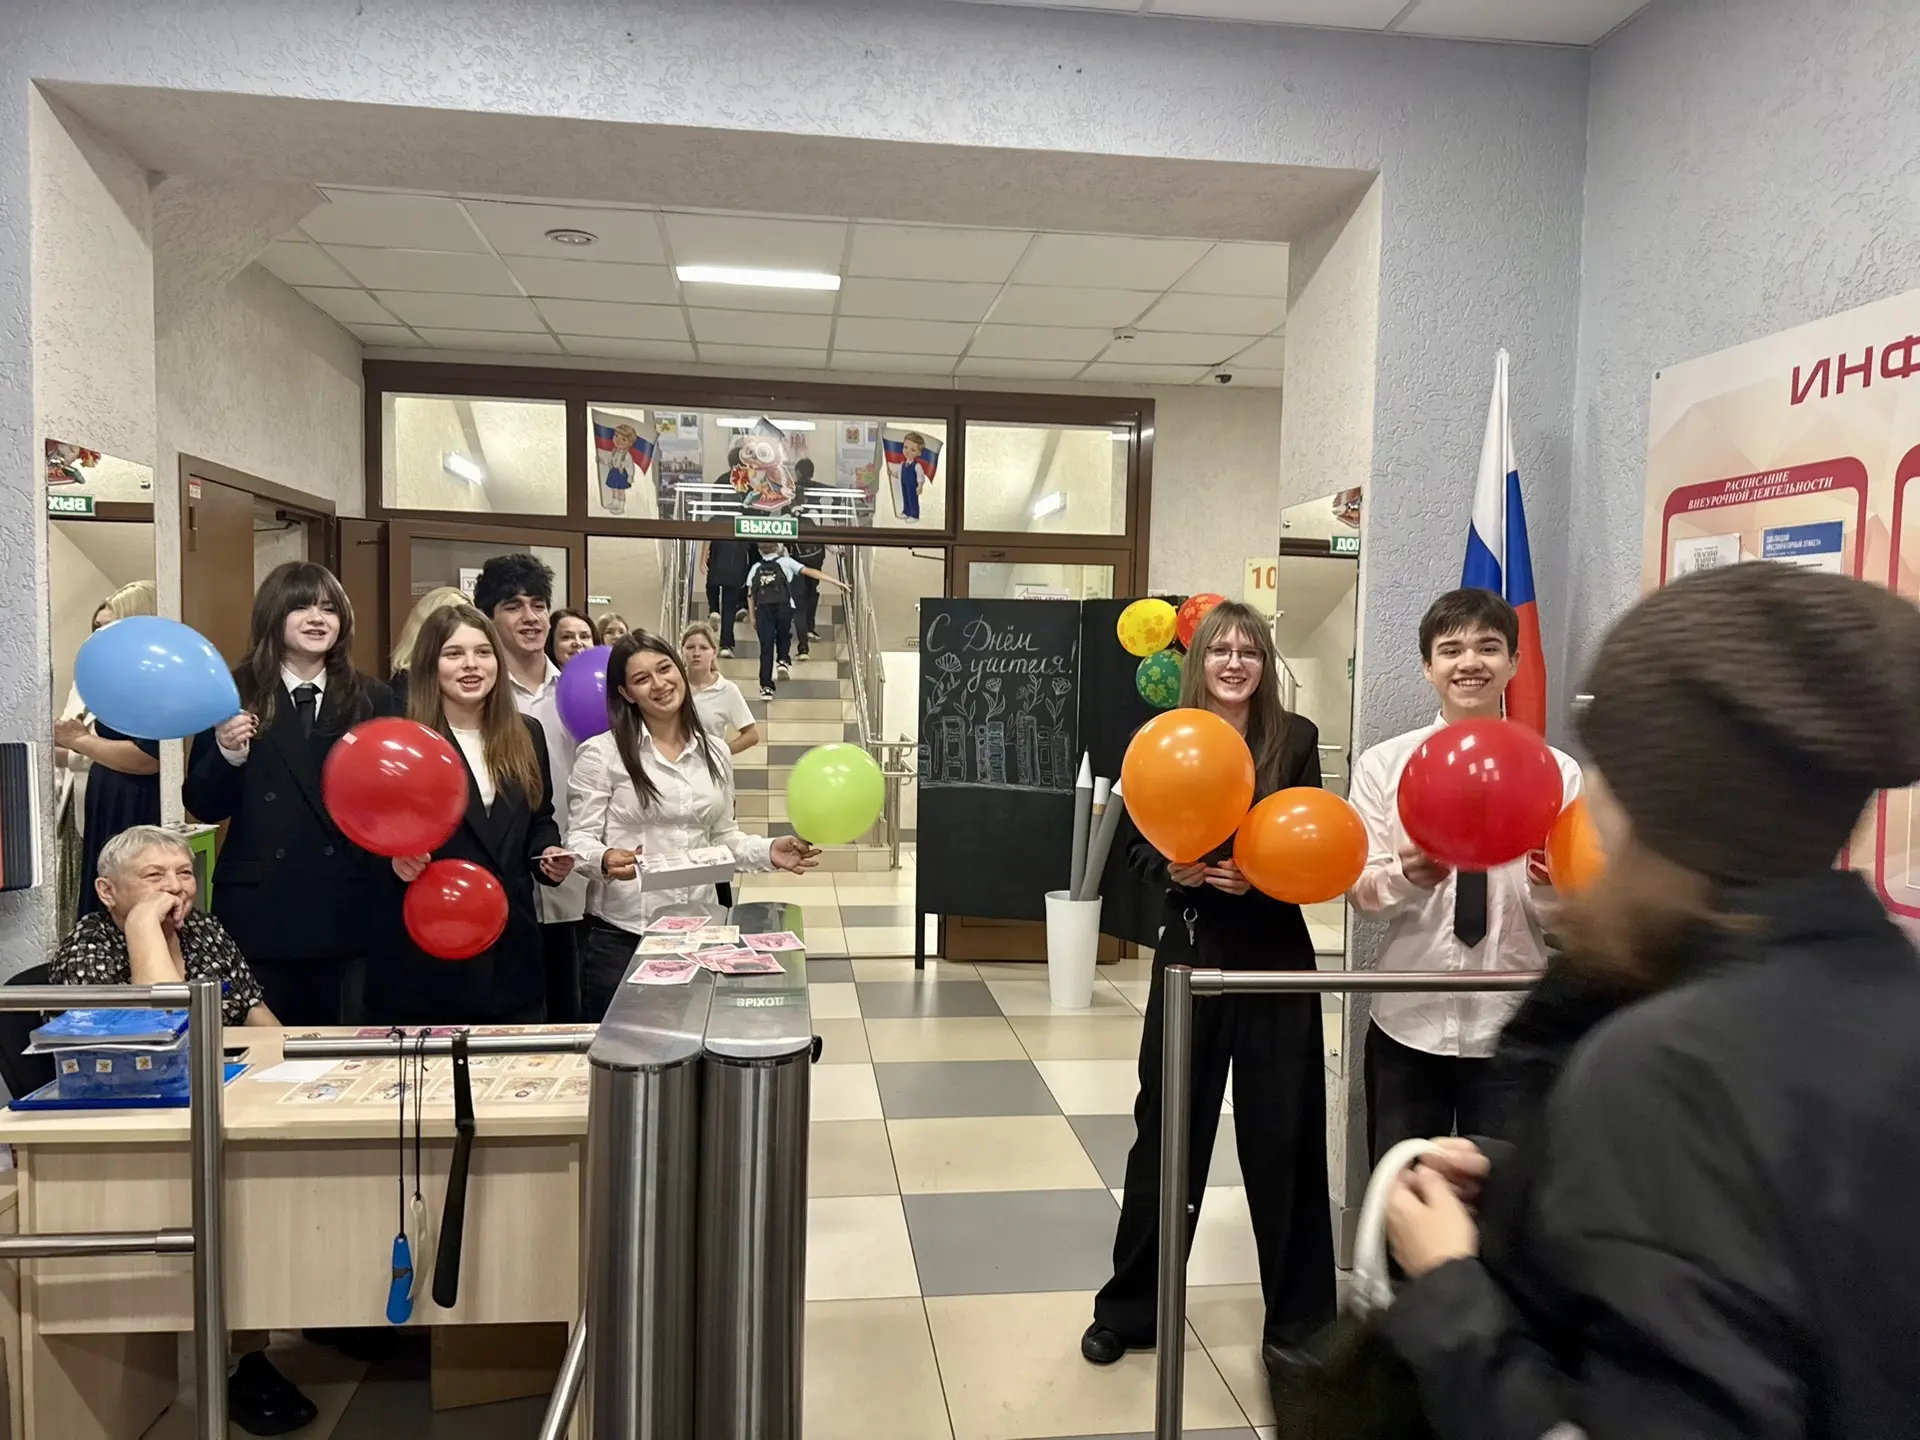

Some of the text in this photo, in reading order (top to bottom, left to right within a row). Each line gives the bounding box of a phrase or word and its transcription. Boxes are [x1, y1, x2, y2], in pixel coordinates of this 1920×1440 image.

[1687, 476, 1834, 510] ВНЕУРОЧНОЙ ДЕЯТЕЛЬНОСТИ
[1724, 471, 1790, 492] РАСПИСАНИЕ
[740, 520, 792, 535] ВЫХОД
[926, 613, 1040, 653] С Днём
